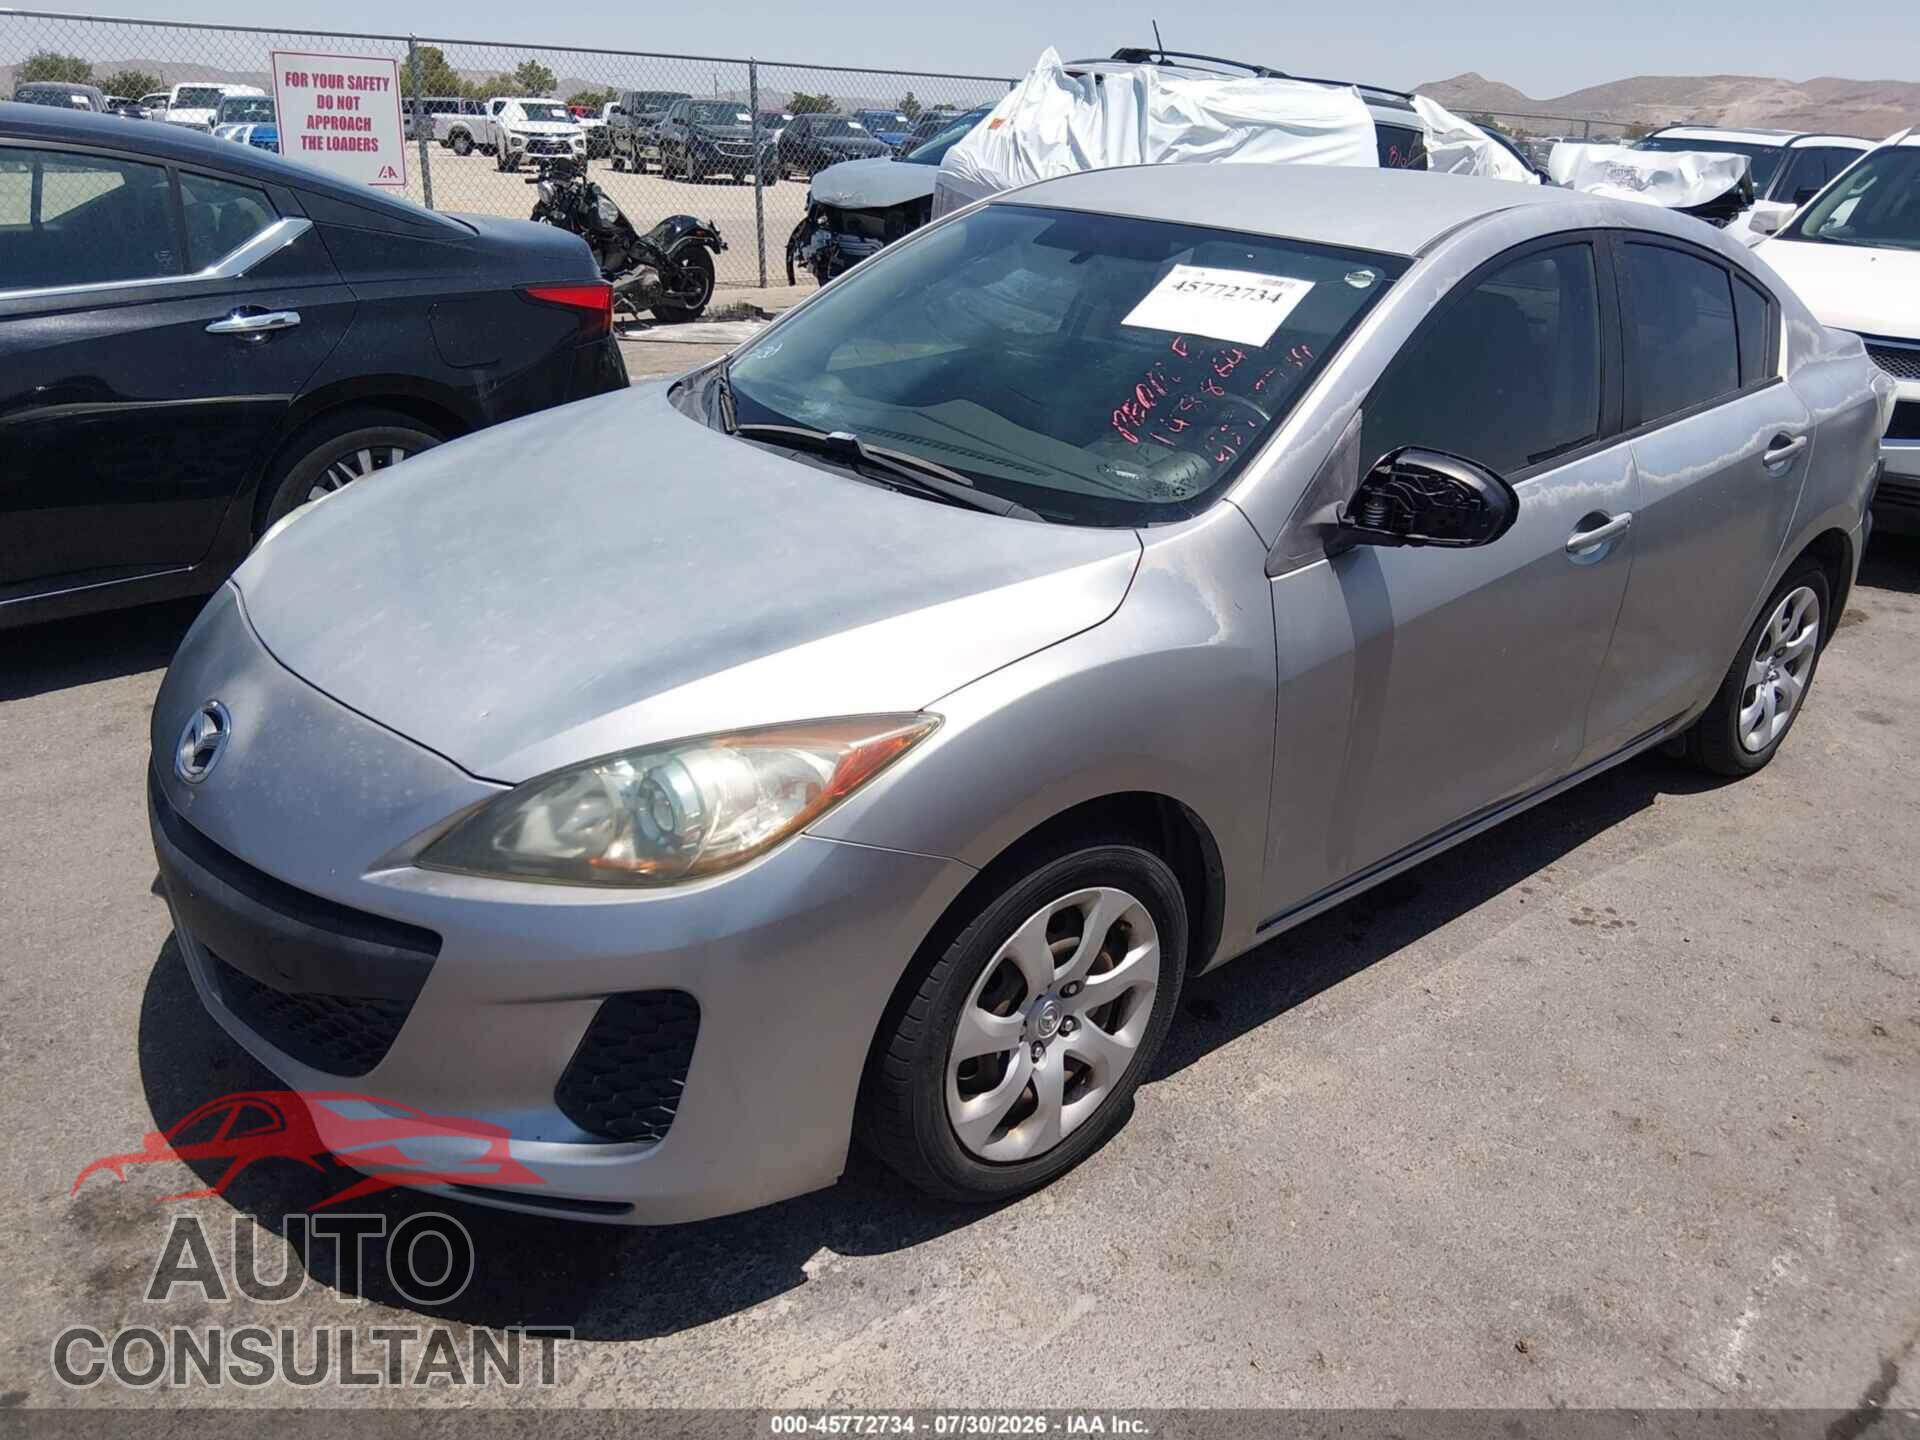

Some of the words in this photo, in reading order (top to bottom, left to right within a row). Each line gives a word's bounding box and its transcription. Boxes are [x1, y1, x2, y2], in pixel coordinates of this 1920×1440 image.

[285, 72, 309, 88] FOR
[311, 73, 344, 90] YOUR
[347, 75, 390, 92] SAFETY
[317, 95, 333, 110] DO
[337, 96, 360, 111] NOT
[306, 115, 372, 131] APPROACH
[301, 135, 323, 151] THE
[326, 136, 379, 152] LOADERS
[1172, 280, 1284, 304] 45772734
